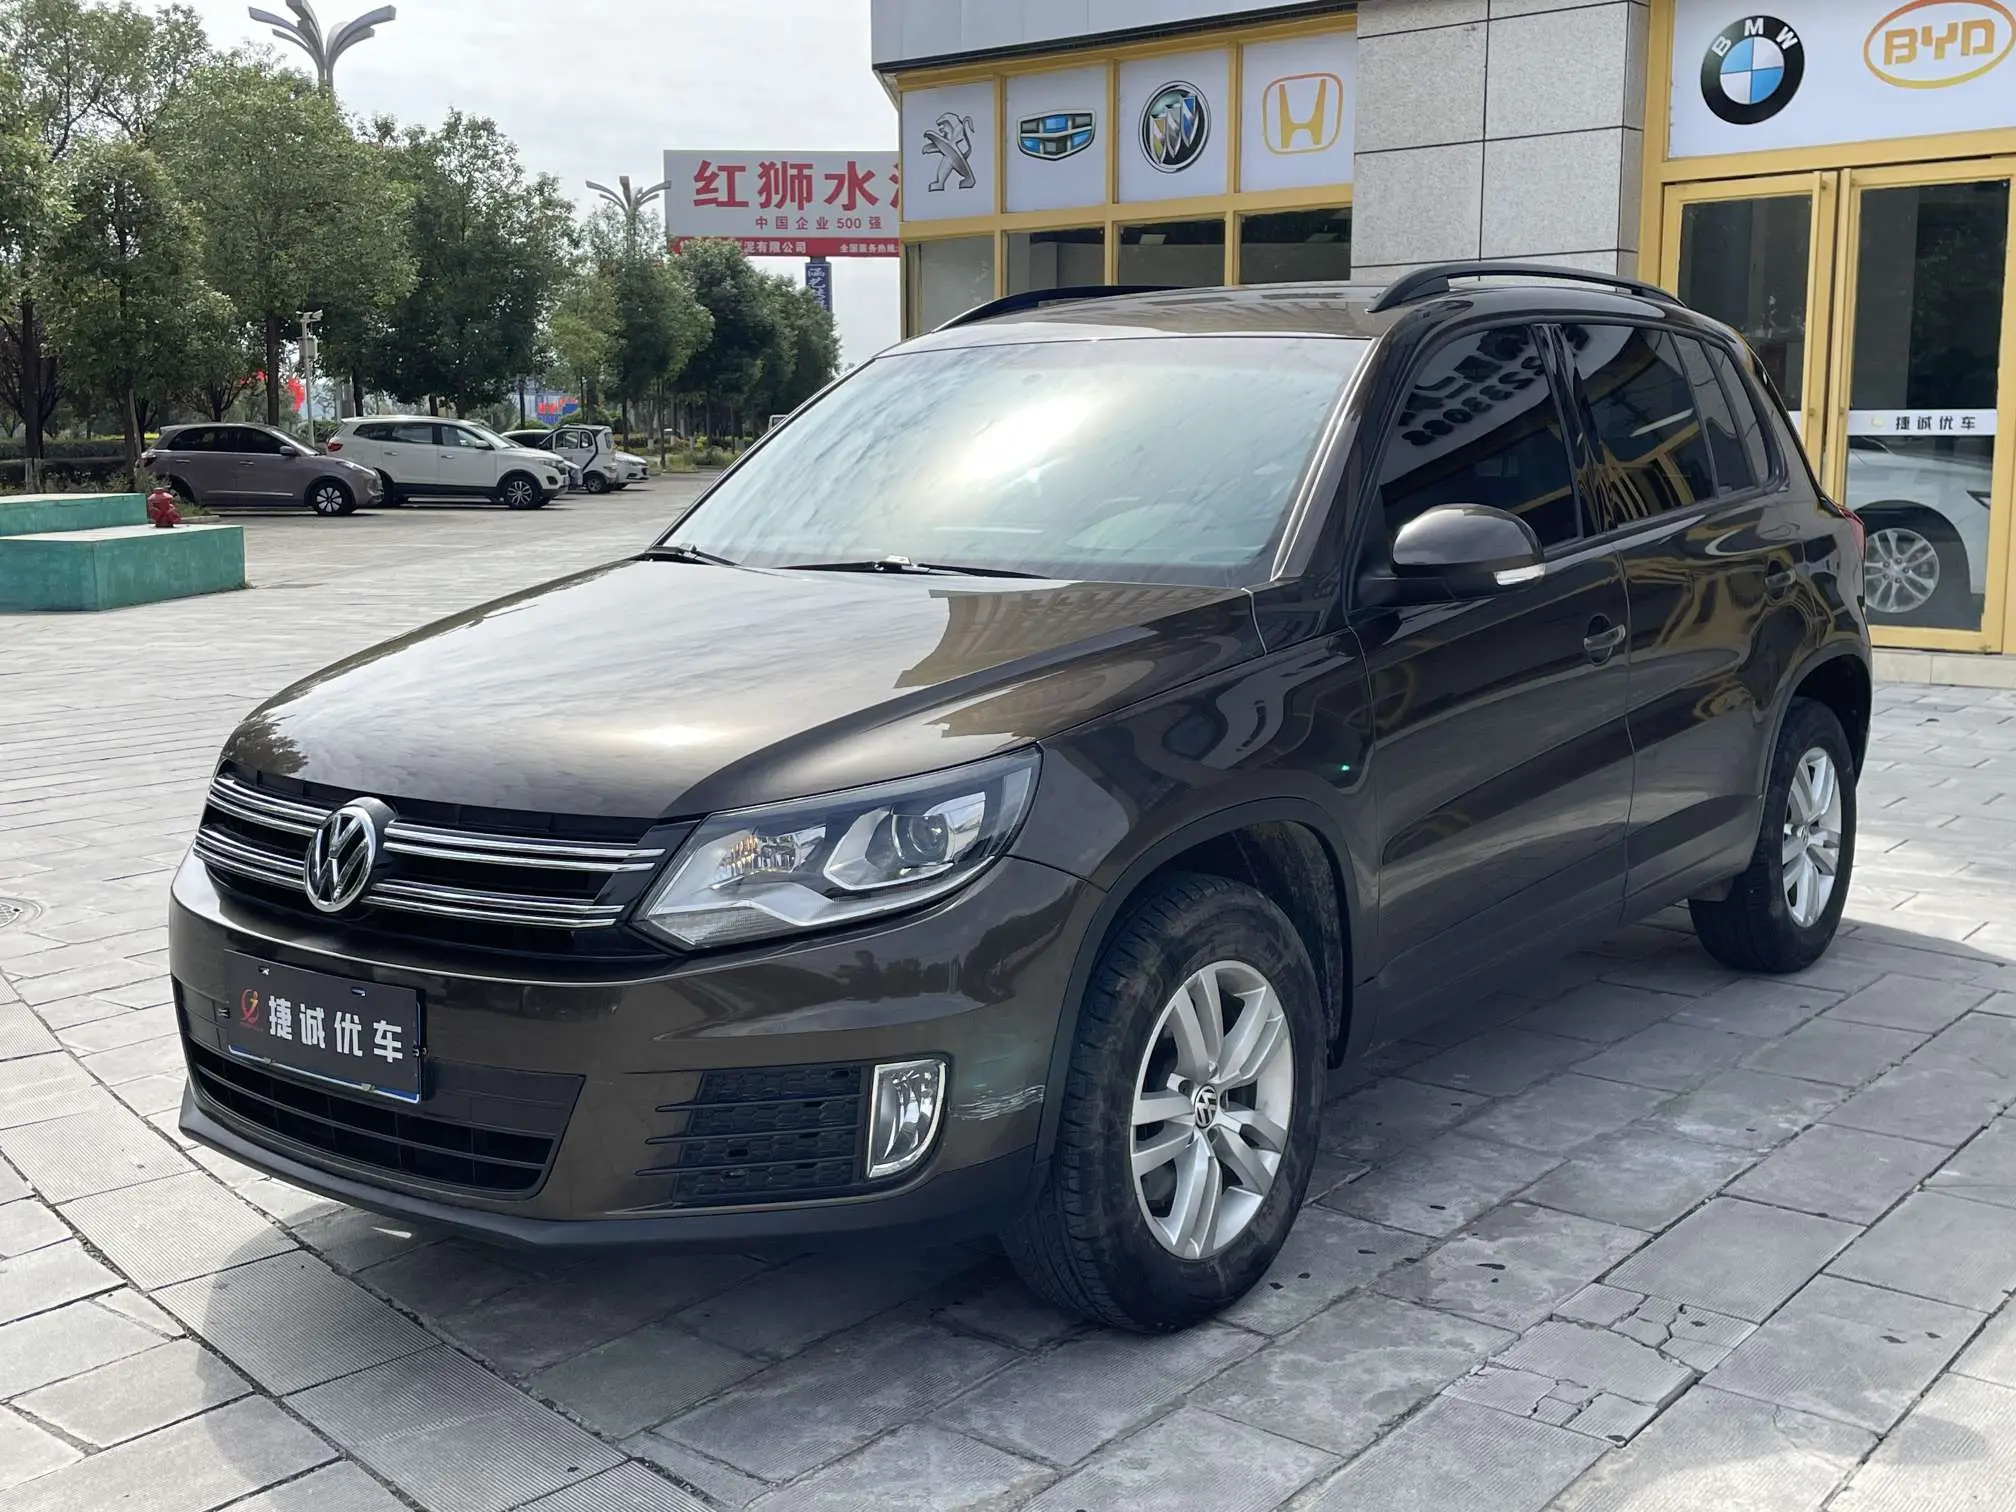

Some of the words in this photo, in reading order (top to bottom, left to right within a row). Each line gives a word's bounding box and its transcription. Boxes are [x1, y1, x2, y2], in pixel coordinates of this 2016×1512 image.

[1711, 17, 1799, 58] BMW
[1883, 18, 1996, 66] BYD
[693, 160, 898, 211] 红狮水
[1896, 416, 1976, 431] 捷诚优车
[268, 995, 404, 1063] 捷诚优车
